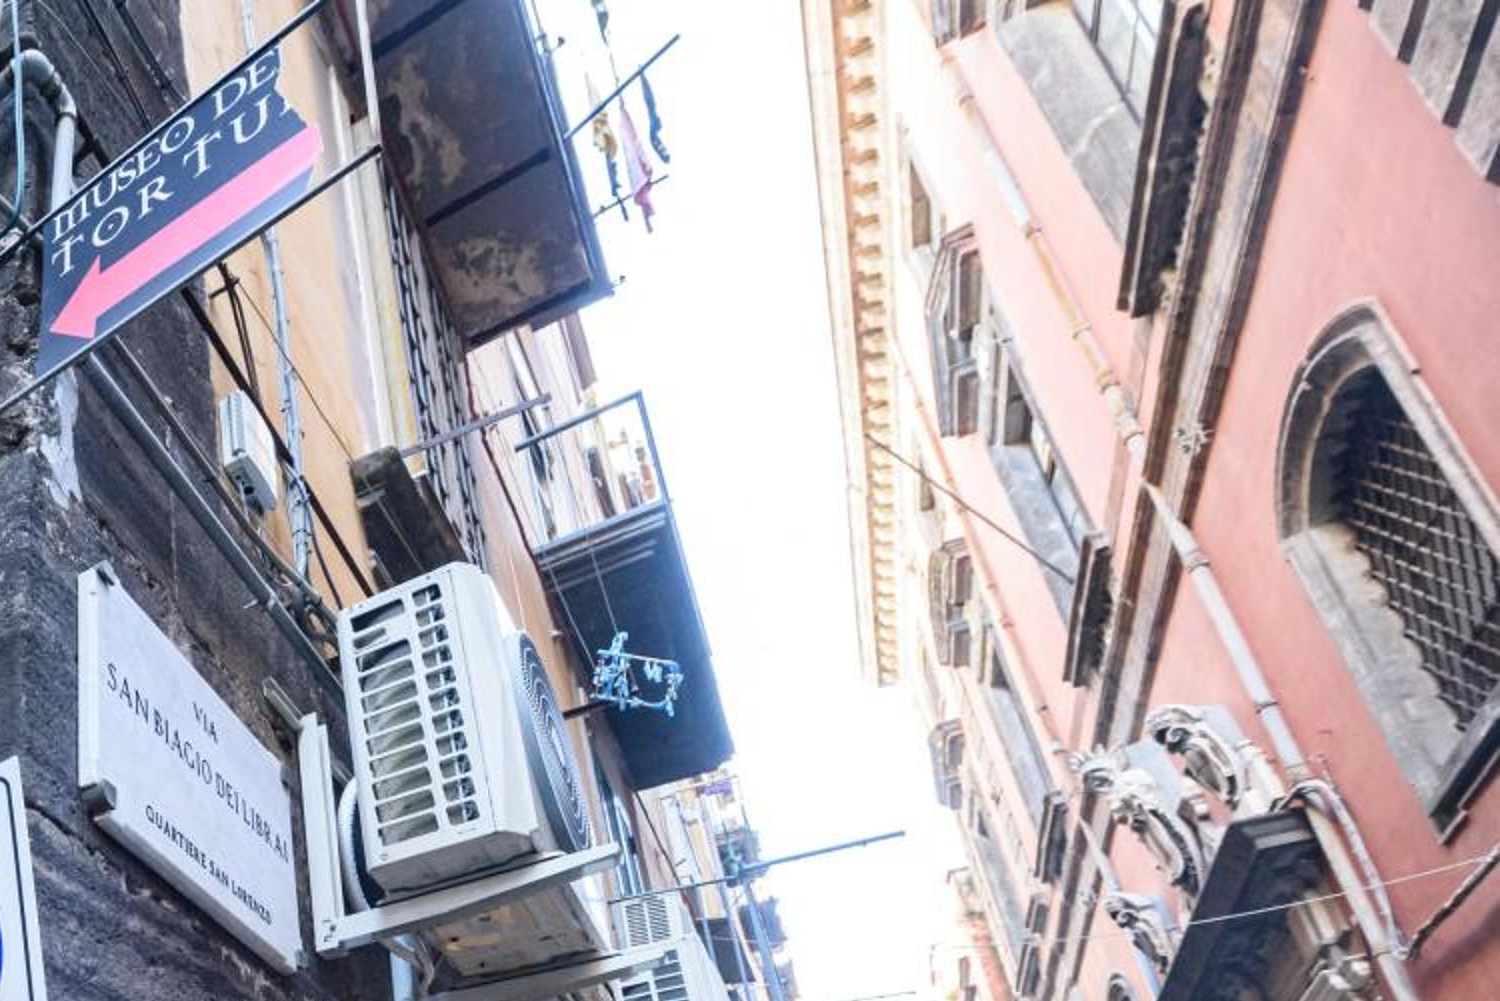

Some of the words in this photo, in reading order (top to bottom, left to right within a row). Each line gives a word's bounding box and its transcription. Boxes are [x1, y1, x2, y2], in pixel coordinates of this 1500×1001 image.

[52, 115, 195, 243] MUSEO
[212, 44, 282, 120] DE
[106, 662, 149, 725] SAN
[153, 708, 213, 785] BIAGIO
[215, 771, 240, 816] DEI
[193, 701, 219, 744] VIA
[145, 804, 208, 871] QUARTIERE
[209, 859, 229, 888] SAN
[231, 879, 273, 926] LORENZO
